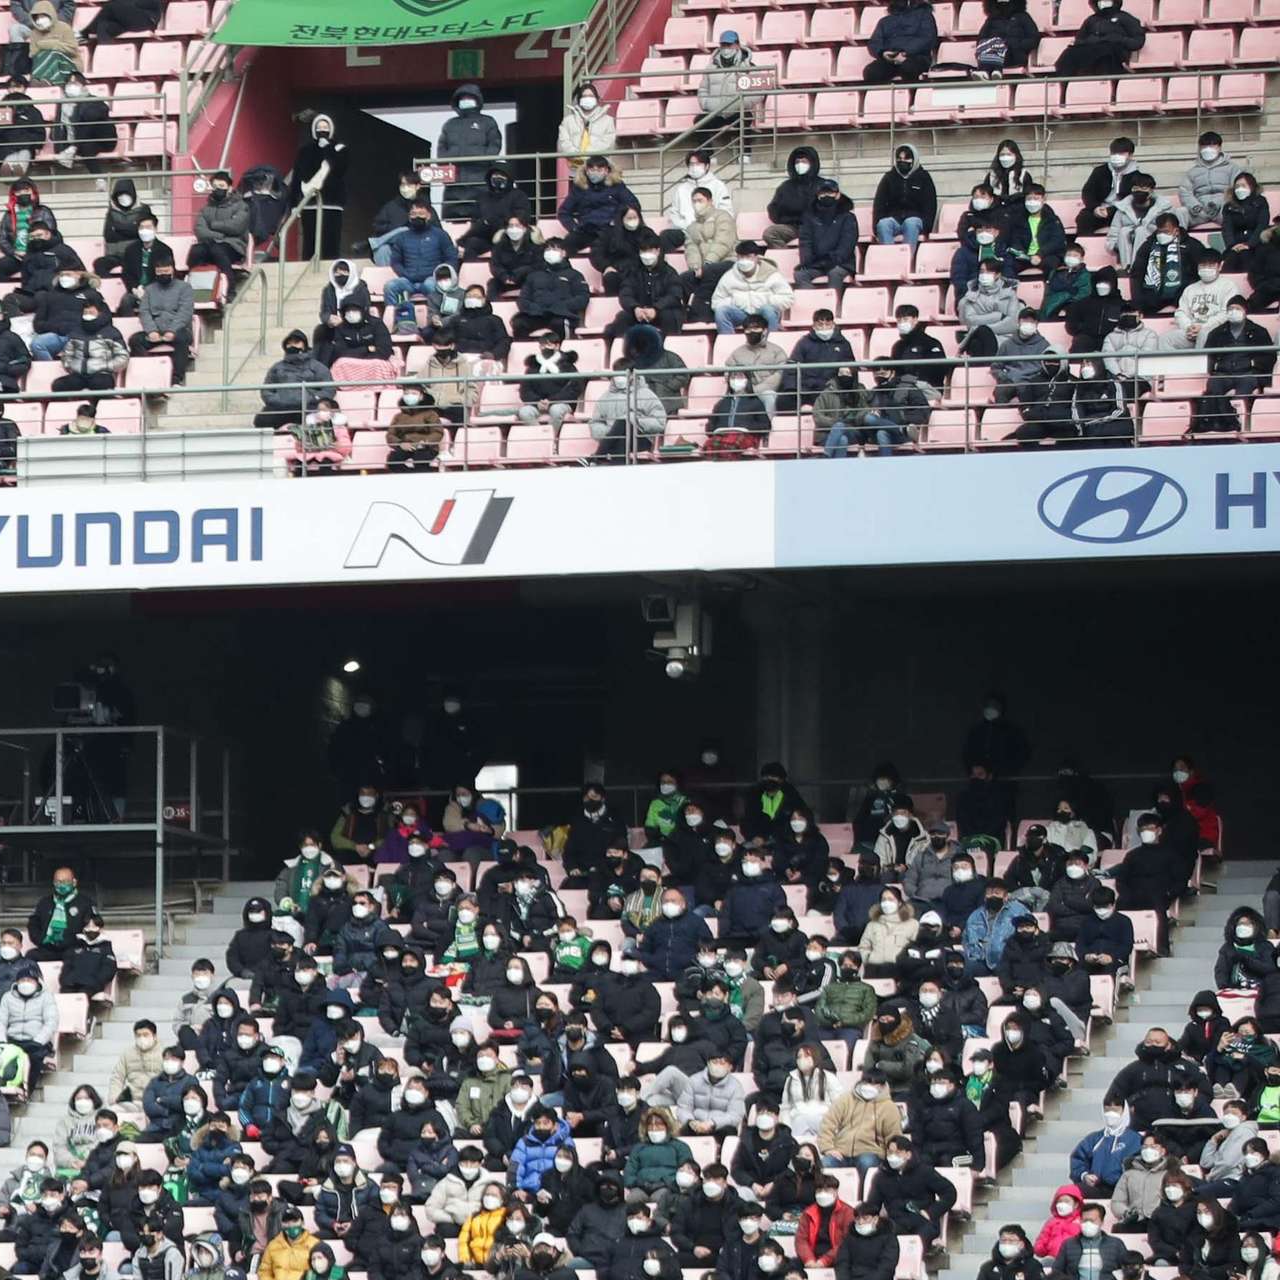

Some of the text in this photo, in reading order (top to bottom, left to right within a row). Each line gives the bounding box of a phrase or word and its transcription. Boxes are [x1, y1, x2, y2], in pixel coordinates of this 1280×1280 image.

[290, 10, 544, 41] 전북현대모터스 FC
[1215, 471, 1280, 530] H
